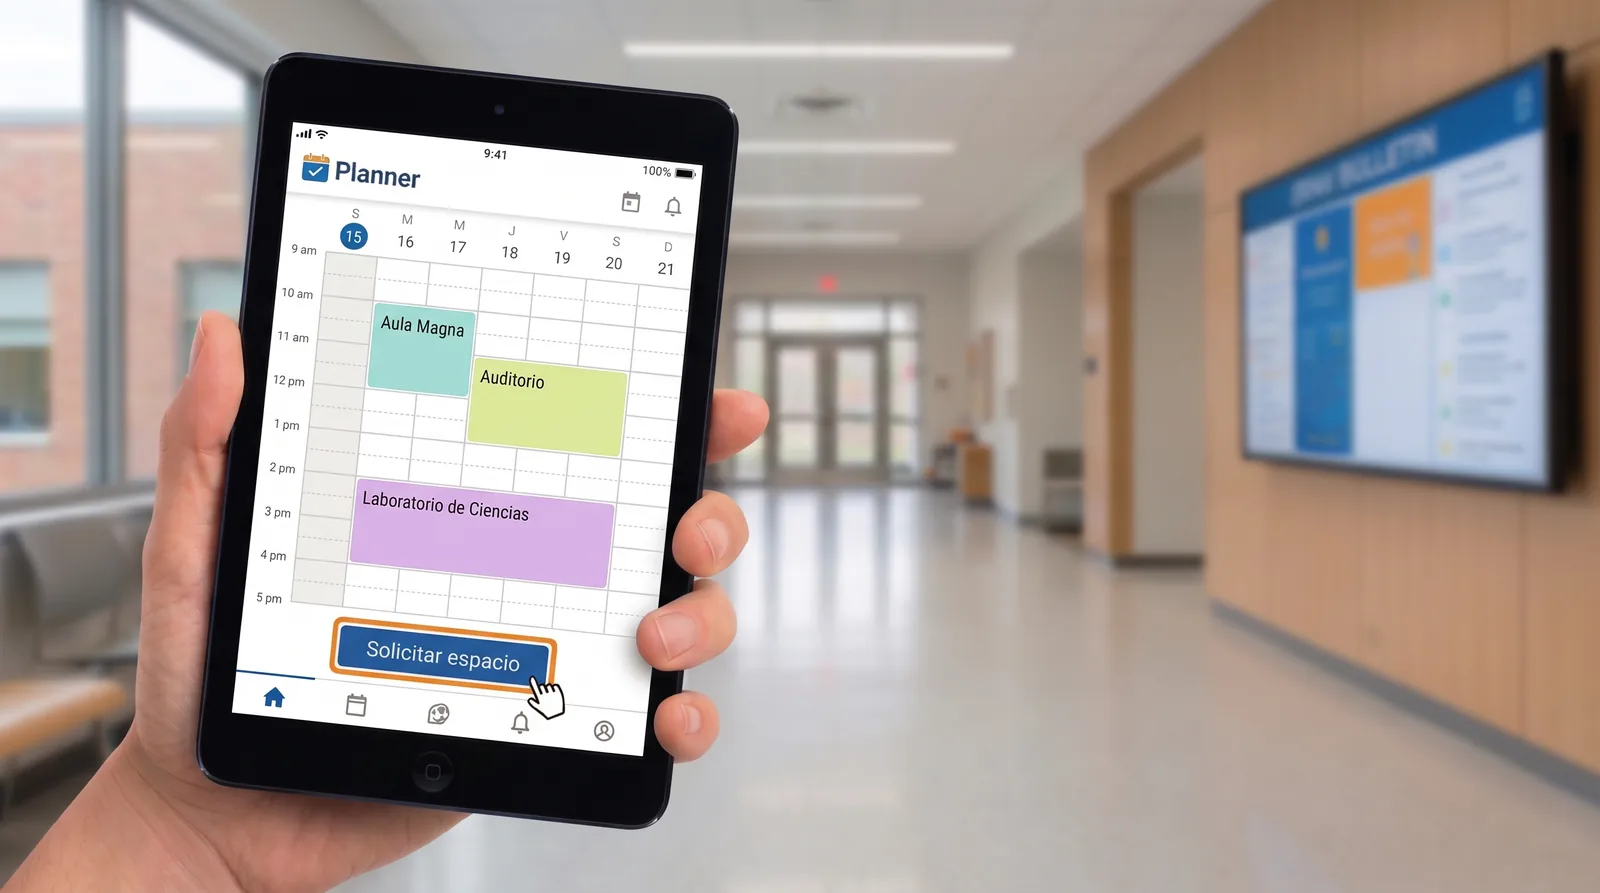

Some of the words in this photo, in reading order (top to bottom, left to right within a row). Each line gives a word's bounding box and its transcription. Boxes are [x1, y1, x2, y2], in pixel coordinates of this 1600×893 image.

[483, 148, 507, 161] 9:41
[335, 160, 421, 189] Planner
[643, 165, 672, 178] 100%
[351, 208, 360, 219] S
[401, 213, 414, 225] M
[454, 219, 466, 231] M
[507, 225, 516, 237] J
[559, 230, 569, 241] V
[612, 235, 621, 247] S
[664, 241, 673, 253] D
[291, 243, 299, 254] 9
[300, 246, 317, 256] am
[346, 230, 362, 244] 15
[398, 234, 414, 249] 16
[450, 240, 467, 254] 17
[502, 245, 519, 260] 18
[554, 251, 571, 265] 19
[605, 256, 623, 270] 20
[657, 261, 673, 276] 21
[282, 287, 295, 298] 10
[296, 290, 314, 300] am
[380, 315, 412, 332] Aula
[416, 318, 465, 340] Magna
[277, 330, 289, 341] 11
[292, 334, 310, 344] am
[273, 374, 286, 386] 12
[287, 378, 305, 388] pm
[479, 369, 545, 390] Auditorio
[274, 418, 280, 429] 1
[282, 421, 300, 432] pm
[269, 461, 277, 473] 2
[278, 465, 296, 476] pm
[264, 505, 272, 517] 3
[273, 509, 291, 520] pm
[362, 490, 444, 513] Laboratorio
[447, 498, 465, 515] de
[469, 501, 530, 522] Ciencias
[260, 549, 268, 560] 4
[269, 552, 287, 563] pm
[256, 591, 264, 603] 5
[265, 595, 283, 606] pm
[366, 640, 443, 664] Solicitar
[447, 652, 520, 672] espacio
